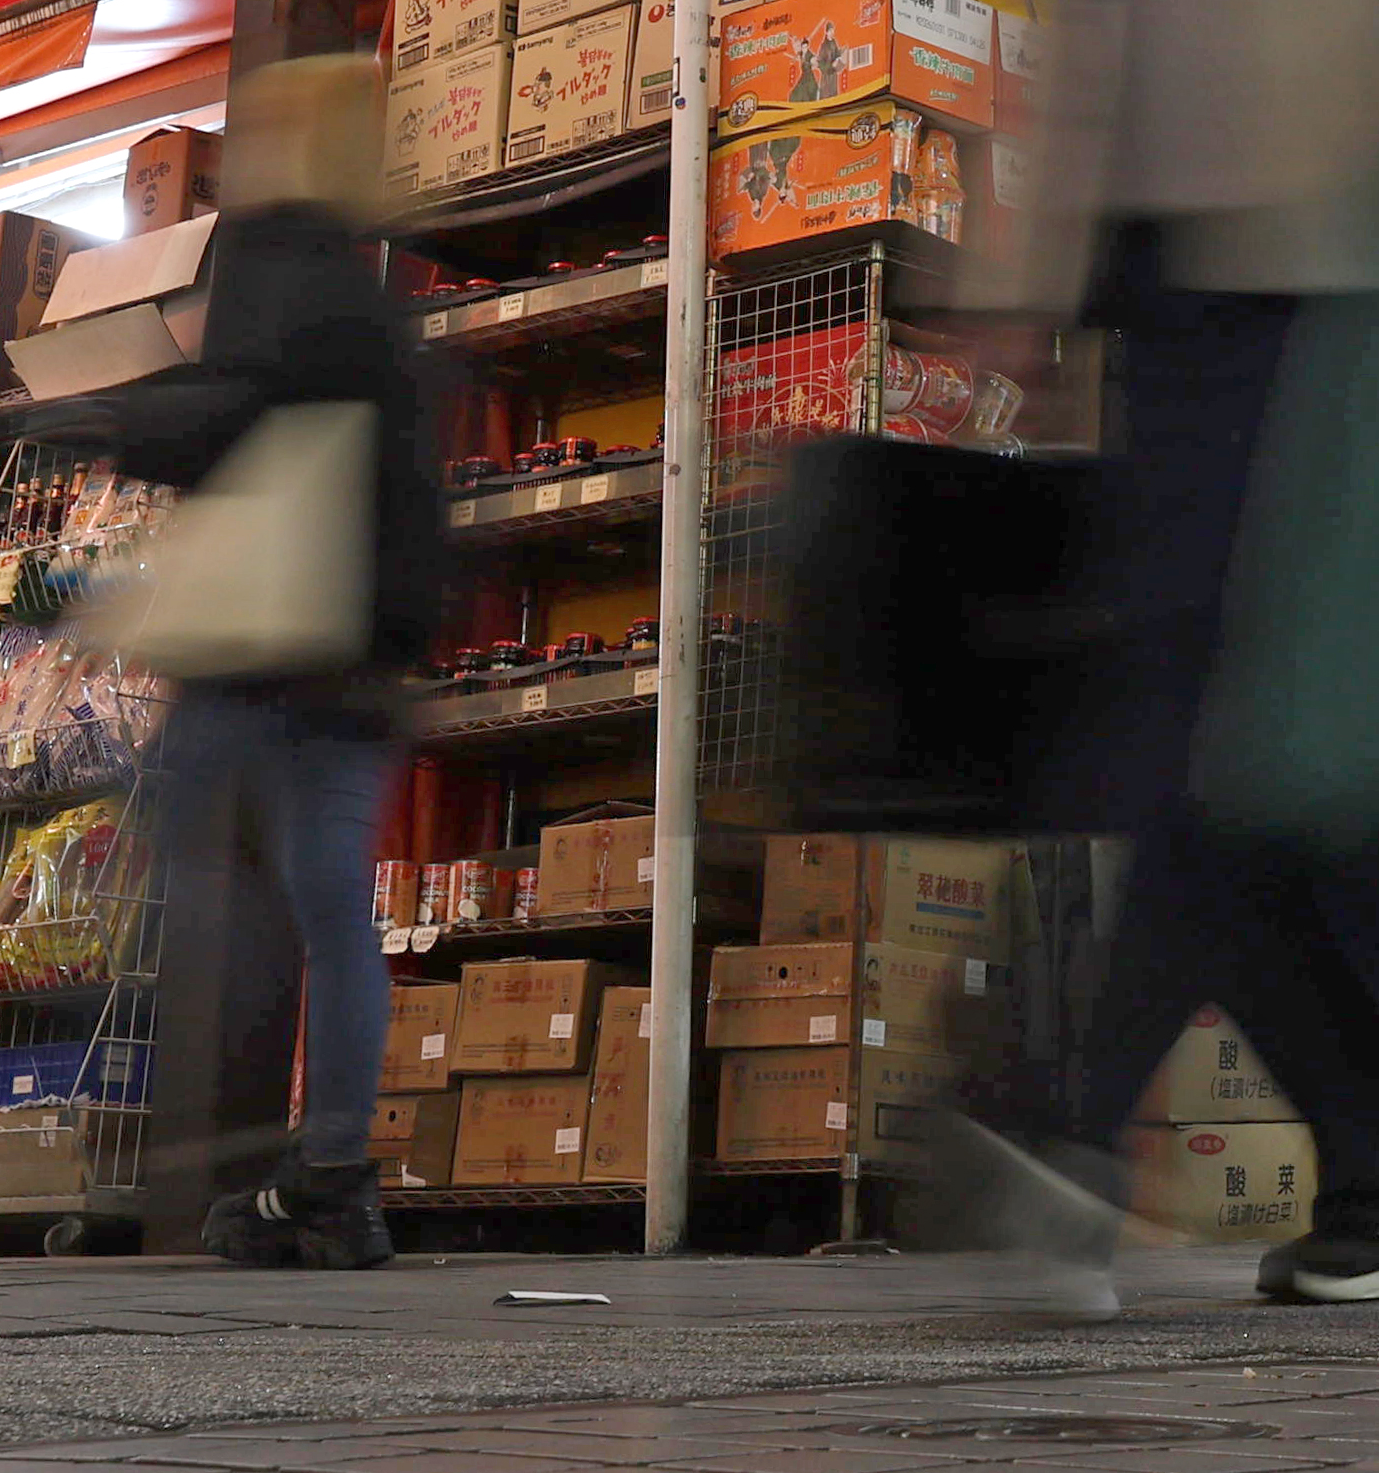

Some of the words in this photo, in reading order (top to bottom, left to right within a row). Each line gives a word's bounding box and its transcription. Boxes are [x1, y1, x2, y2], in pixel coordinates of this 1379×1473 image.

[555, 63, 612, 102] ブルダック
[427, 100, 482, 140] ブルダック
